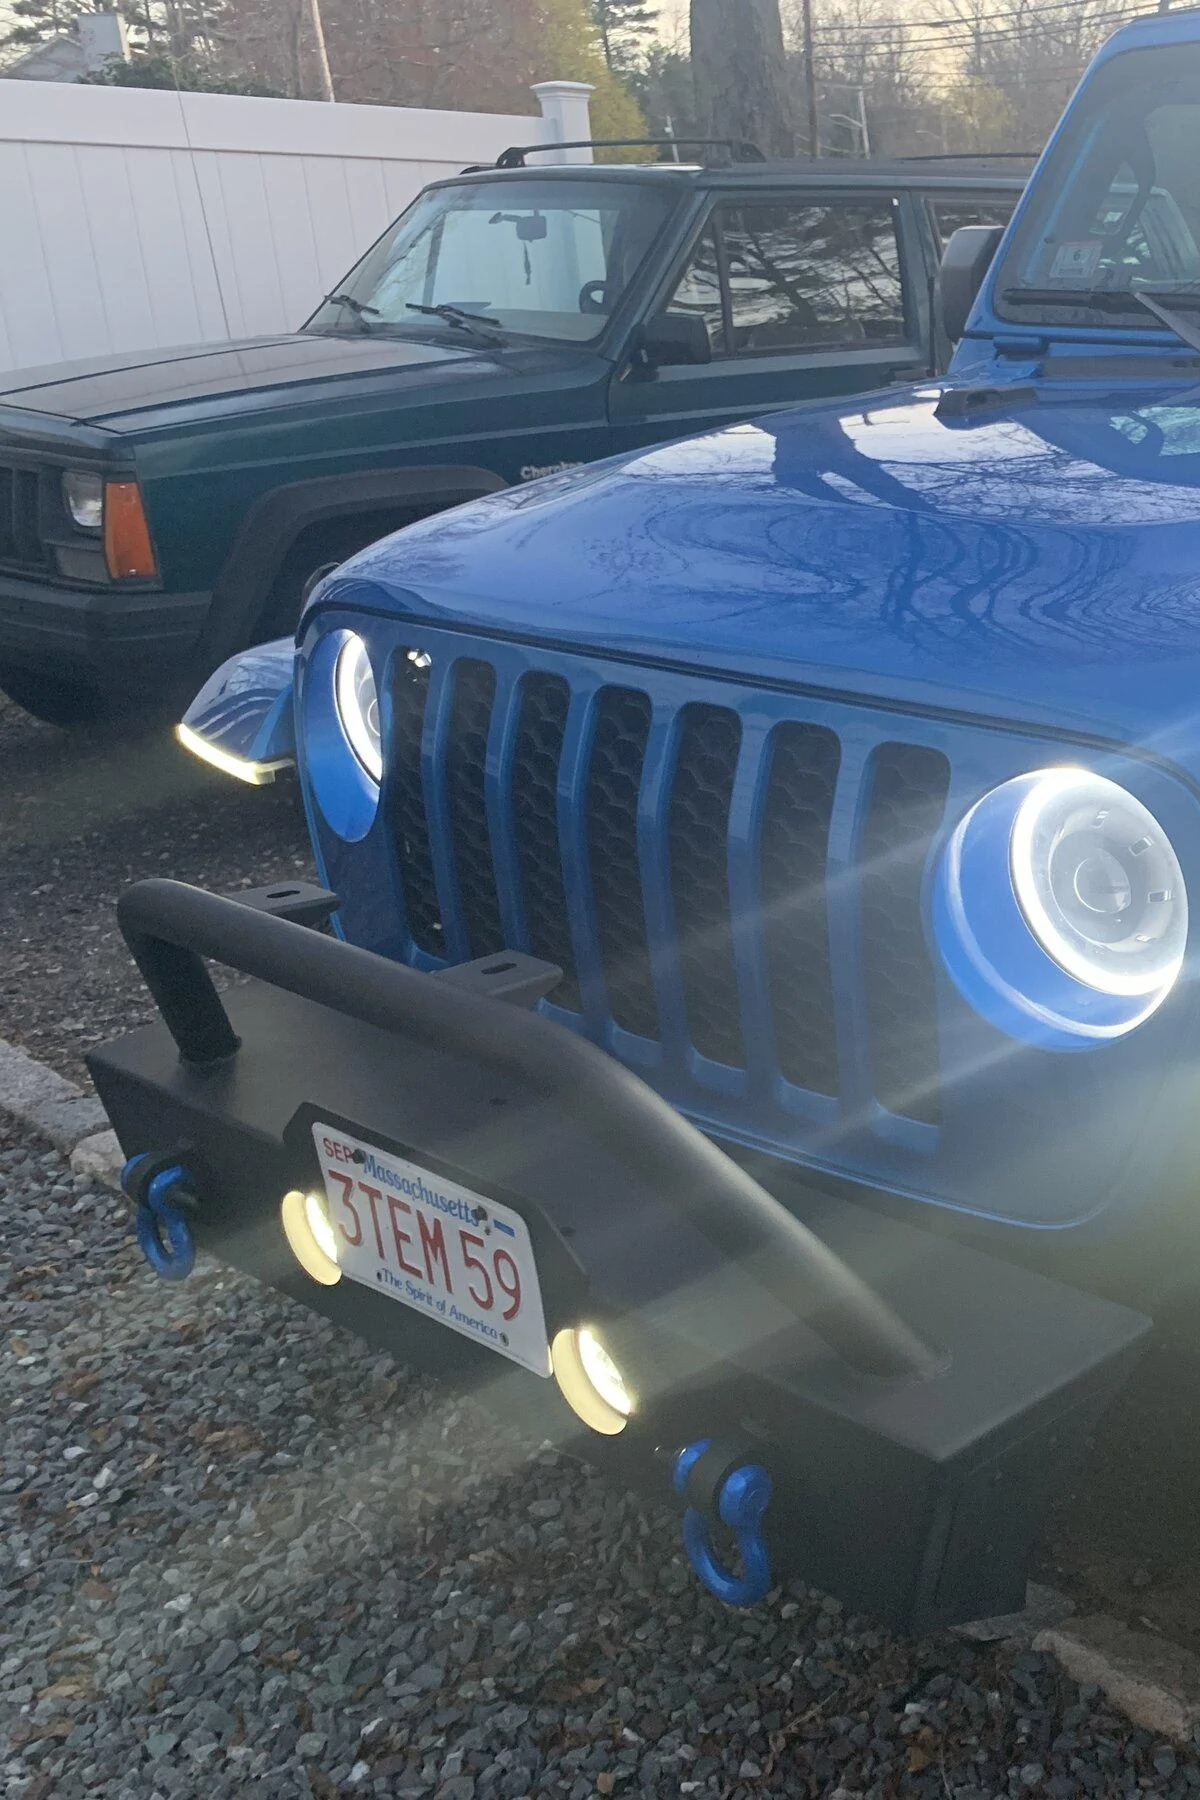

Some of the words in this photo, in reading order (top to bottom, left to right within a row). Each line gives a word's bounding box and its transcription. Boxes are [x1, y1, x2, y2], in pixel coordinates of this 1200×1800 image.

[323, 1138, 353, 1163] SEP
[364, 1154, 480, 1225] Massachusetts
[329, 1169, 453, 1294] 3TEM
[459, 1229, 521, 1321] 59
[382, 1267, 403, 1290] The
[405, 1280, 433, 1307] Spirit
[435, 1300, 446, 1315] of
[450, 1304, 498, 1340] America
